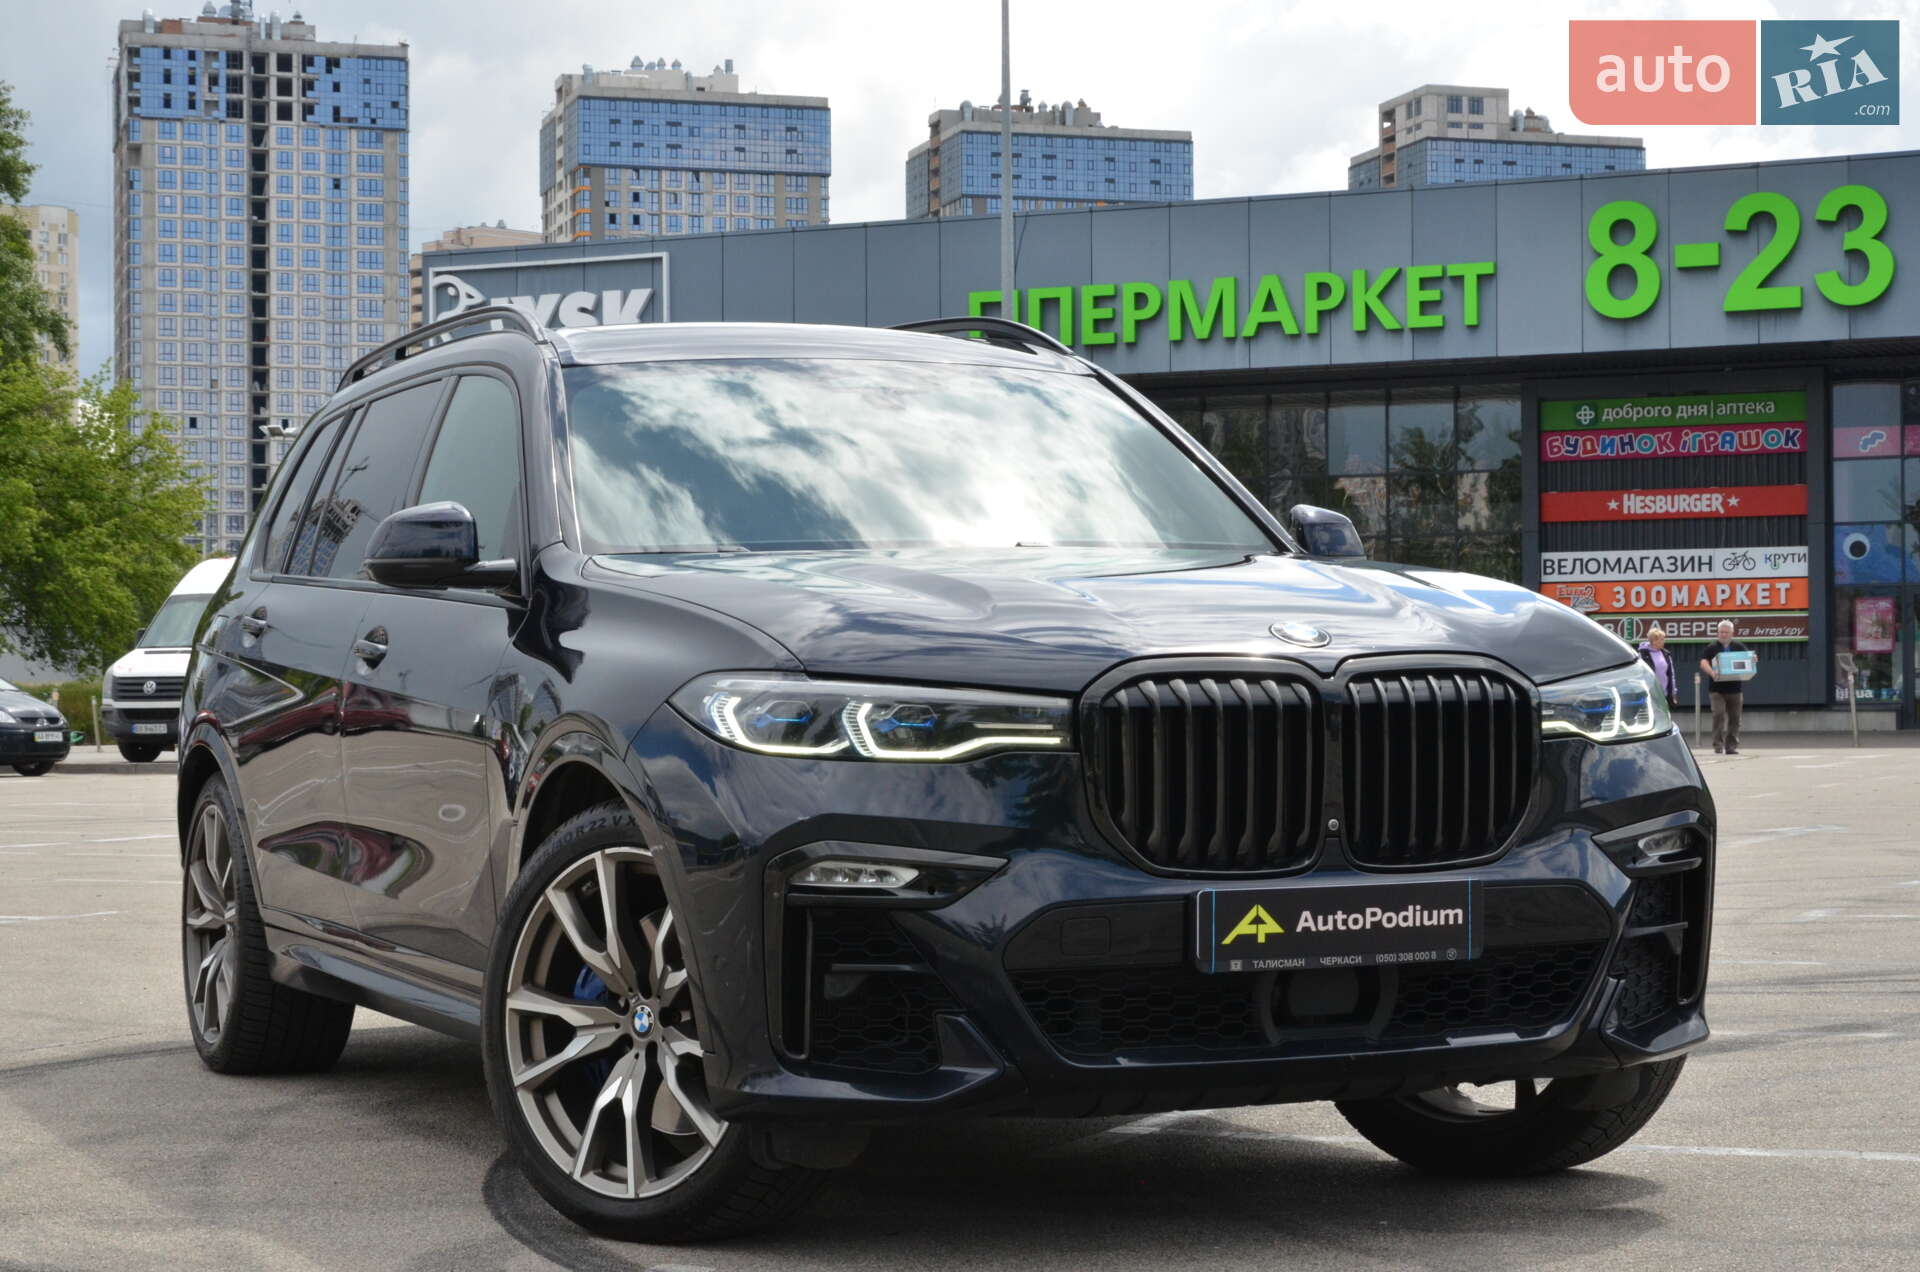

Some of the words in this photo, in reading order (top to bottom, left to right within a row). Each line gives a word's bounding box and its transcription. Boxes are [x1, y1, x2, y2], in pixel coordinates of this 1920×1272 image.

[1584, 184, 1896, 319] 8-23
[1602, 403, 1672, 421] доброго
[1546, 432, 1675, 458] БУДИНОК
[1622, 493, 1725, 514] HESBURGER
[1543, 555, 1713, 576] ВЕЛОМАГАЗИН
[1612, 582, 1791, 609] ЗООМАРКЕТ
[1296, 905, 1463, 932] AutoPodium
[1252, 958, 1305, 969] ТАЛИСМАН
[1319, 956, 1362, 965] ЧЕРКАСИ
